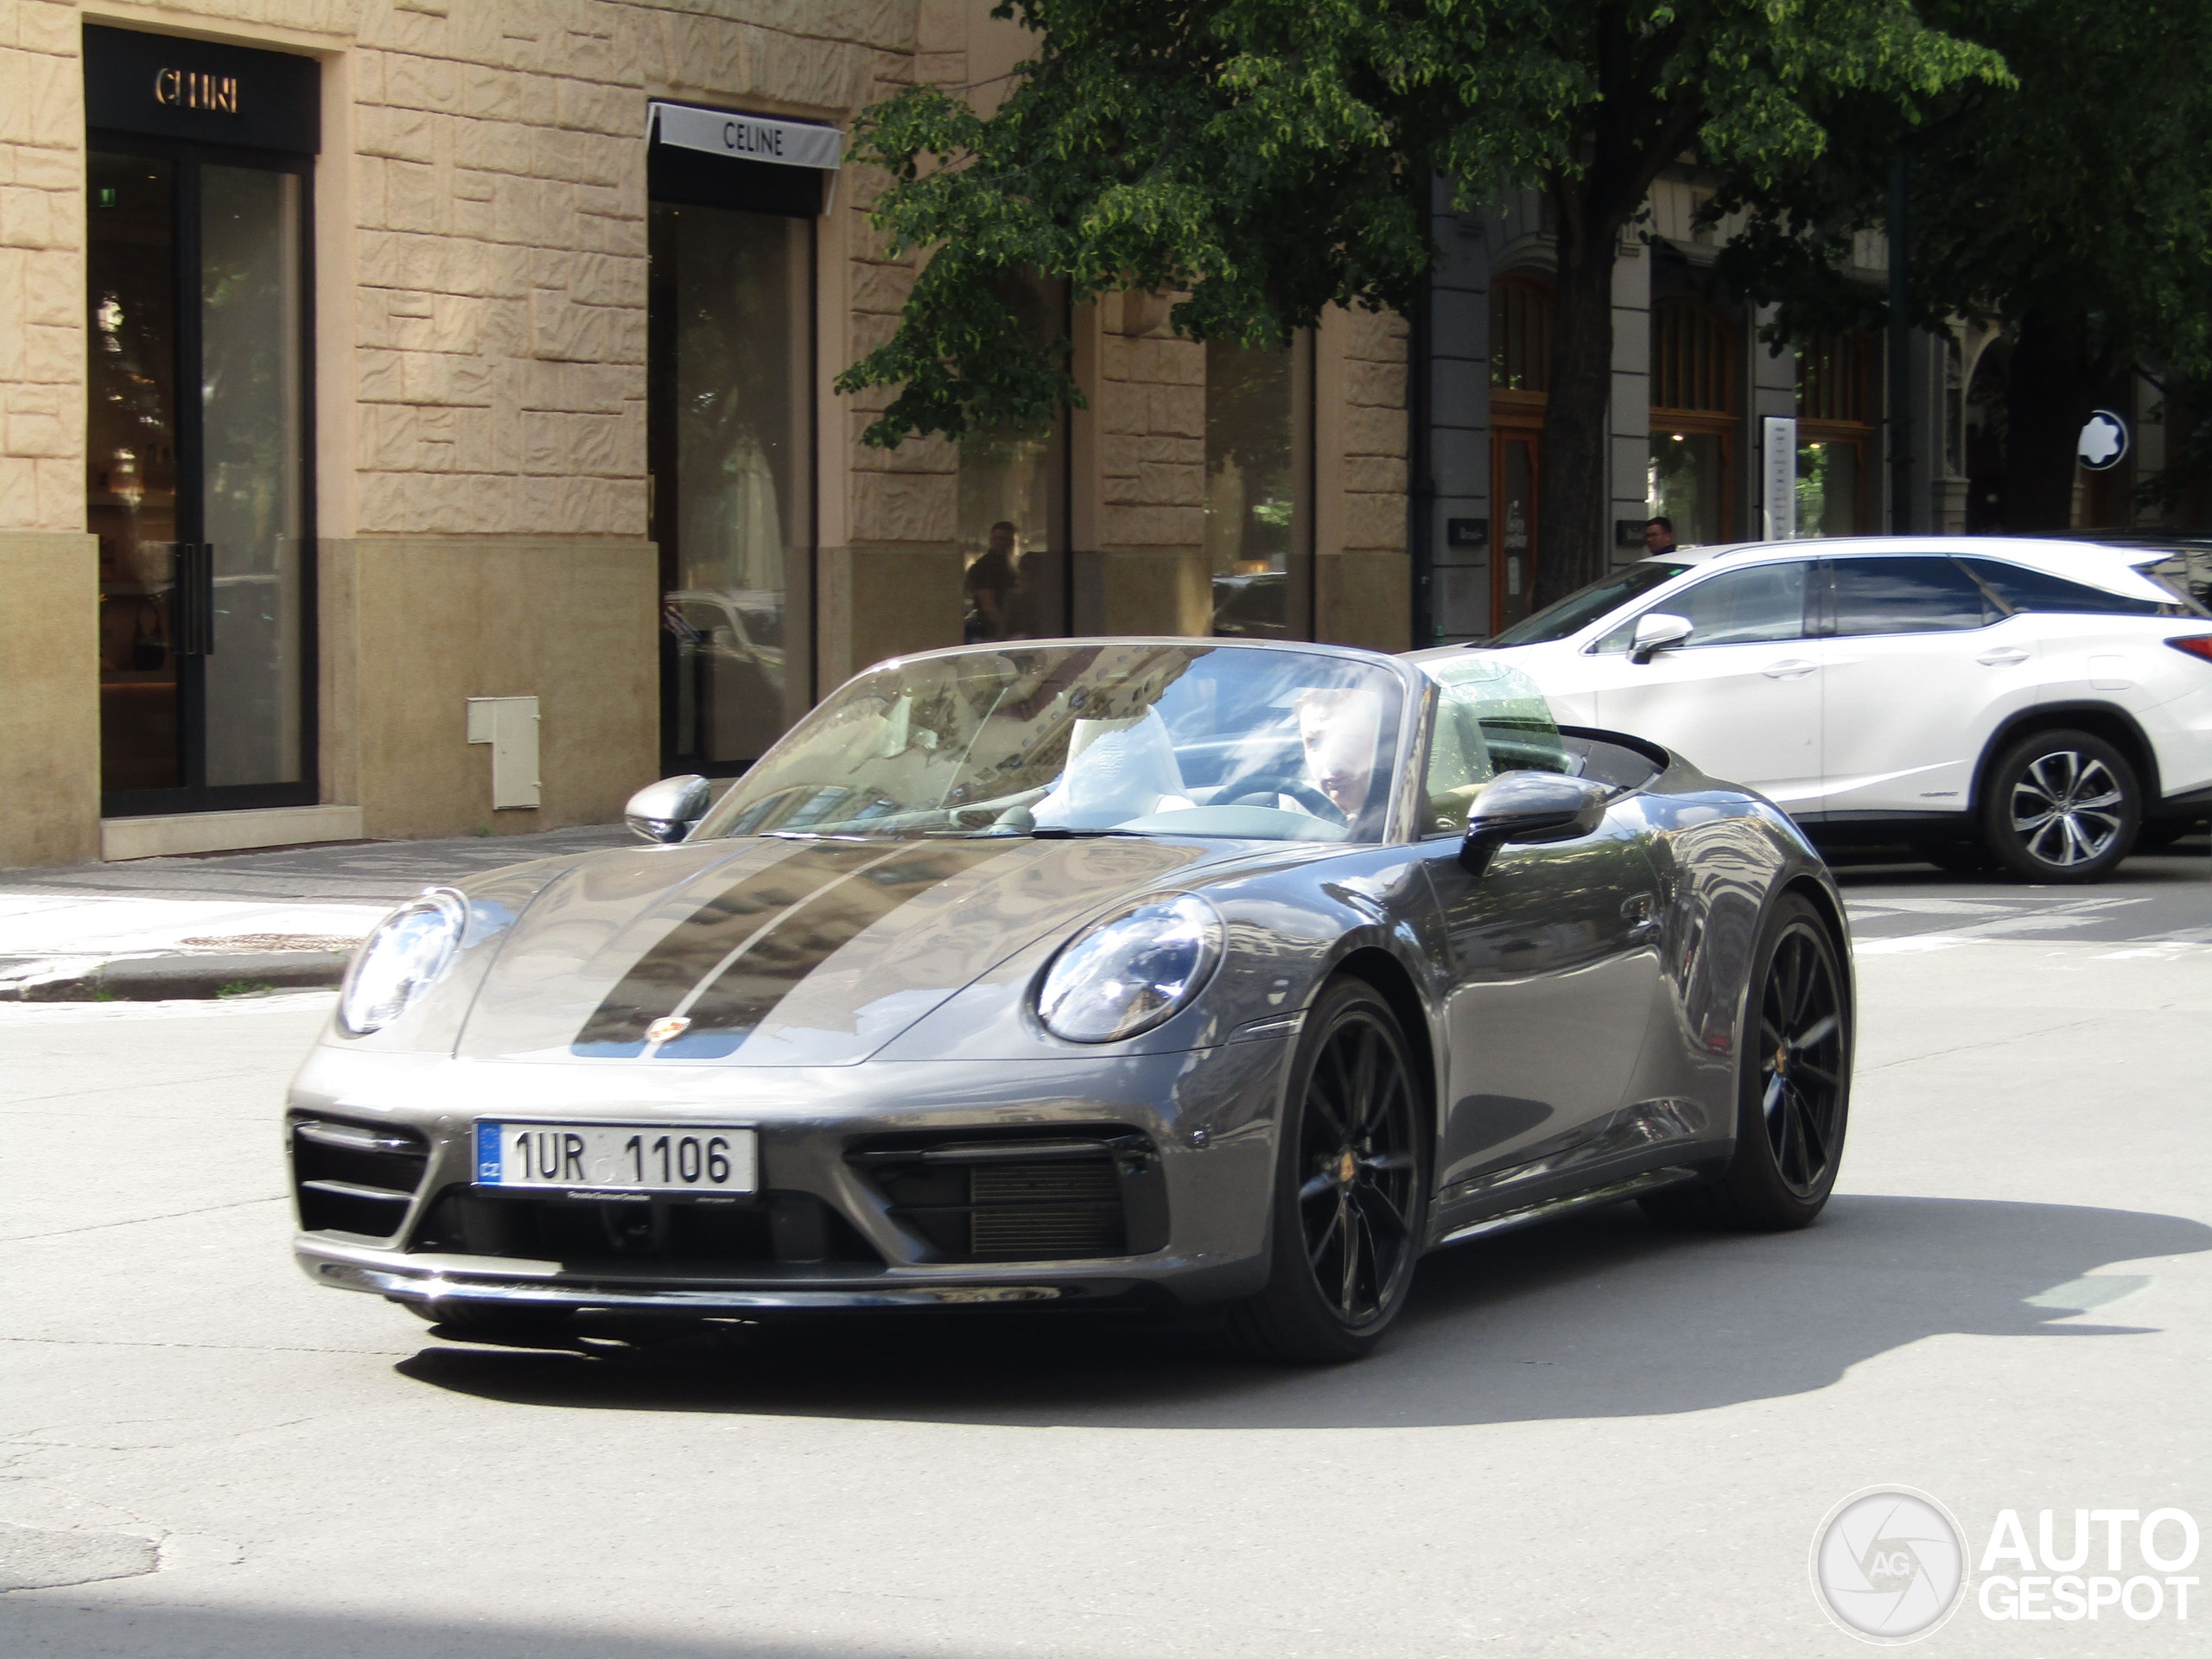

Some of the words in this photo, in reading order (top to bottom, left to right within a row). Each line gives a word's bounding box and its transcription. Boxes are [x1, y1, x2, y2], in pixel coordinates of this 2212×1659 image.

[723, 122, 783, 156] CELINE
[479, 1161, 500, 1178] CZ
[513, 1130, 586, 1180] 1UR
[625, 1134, 731, 1184] 1106
